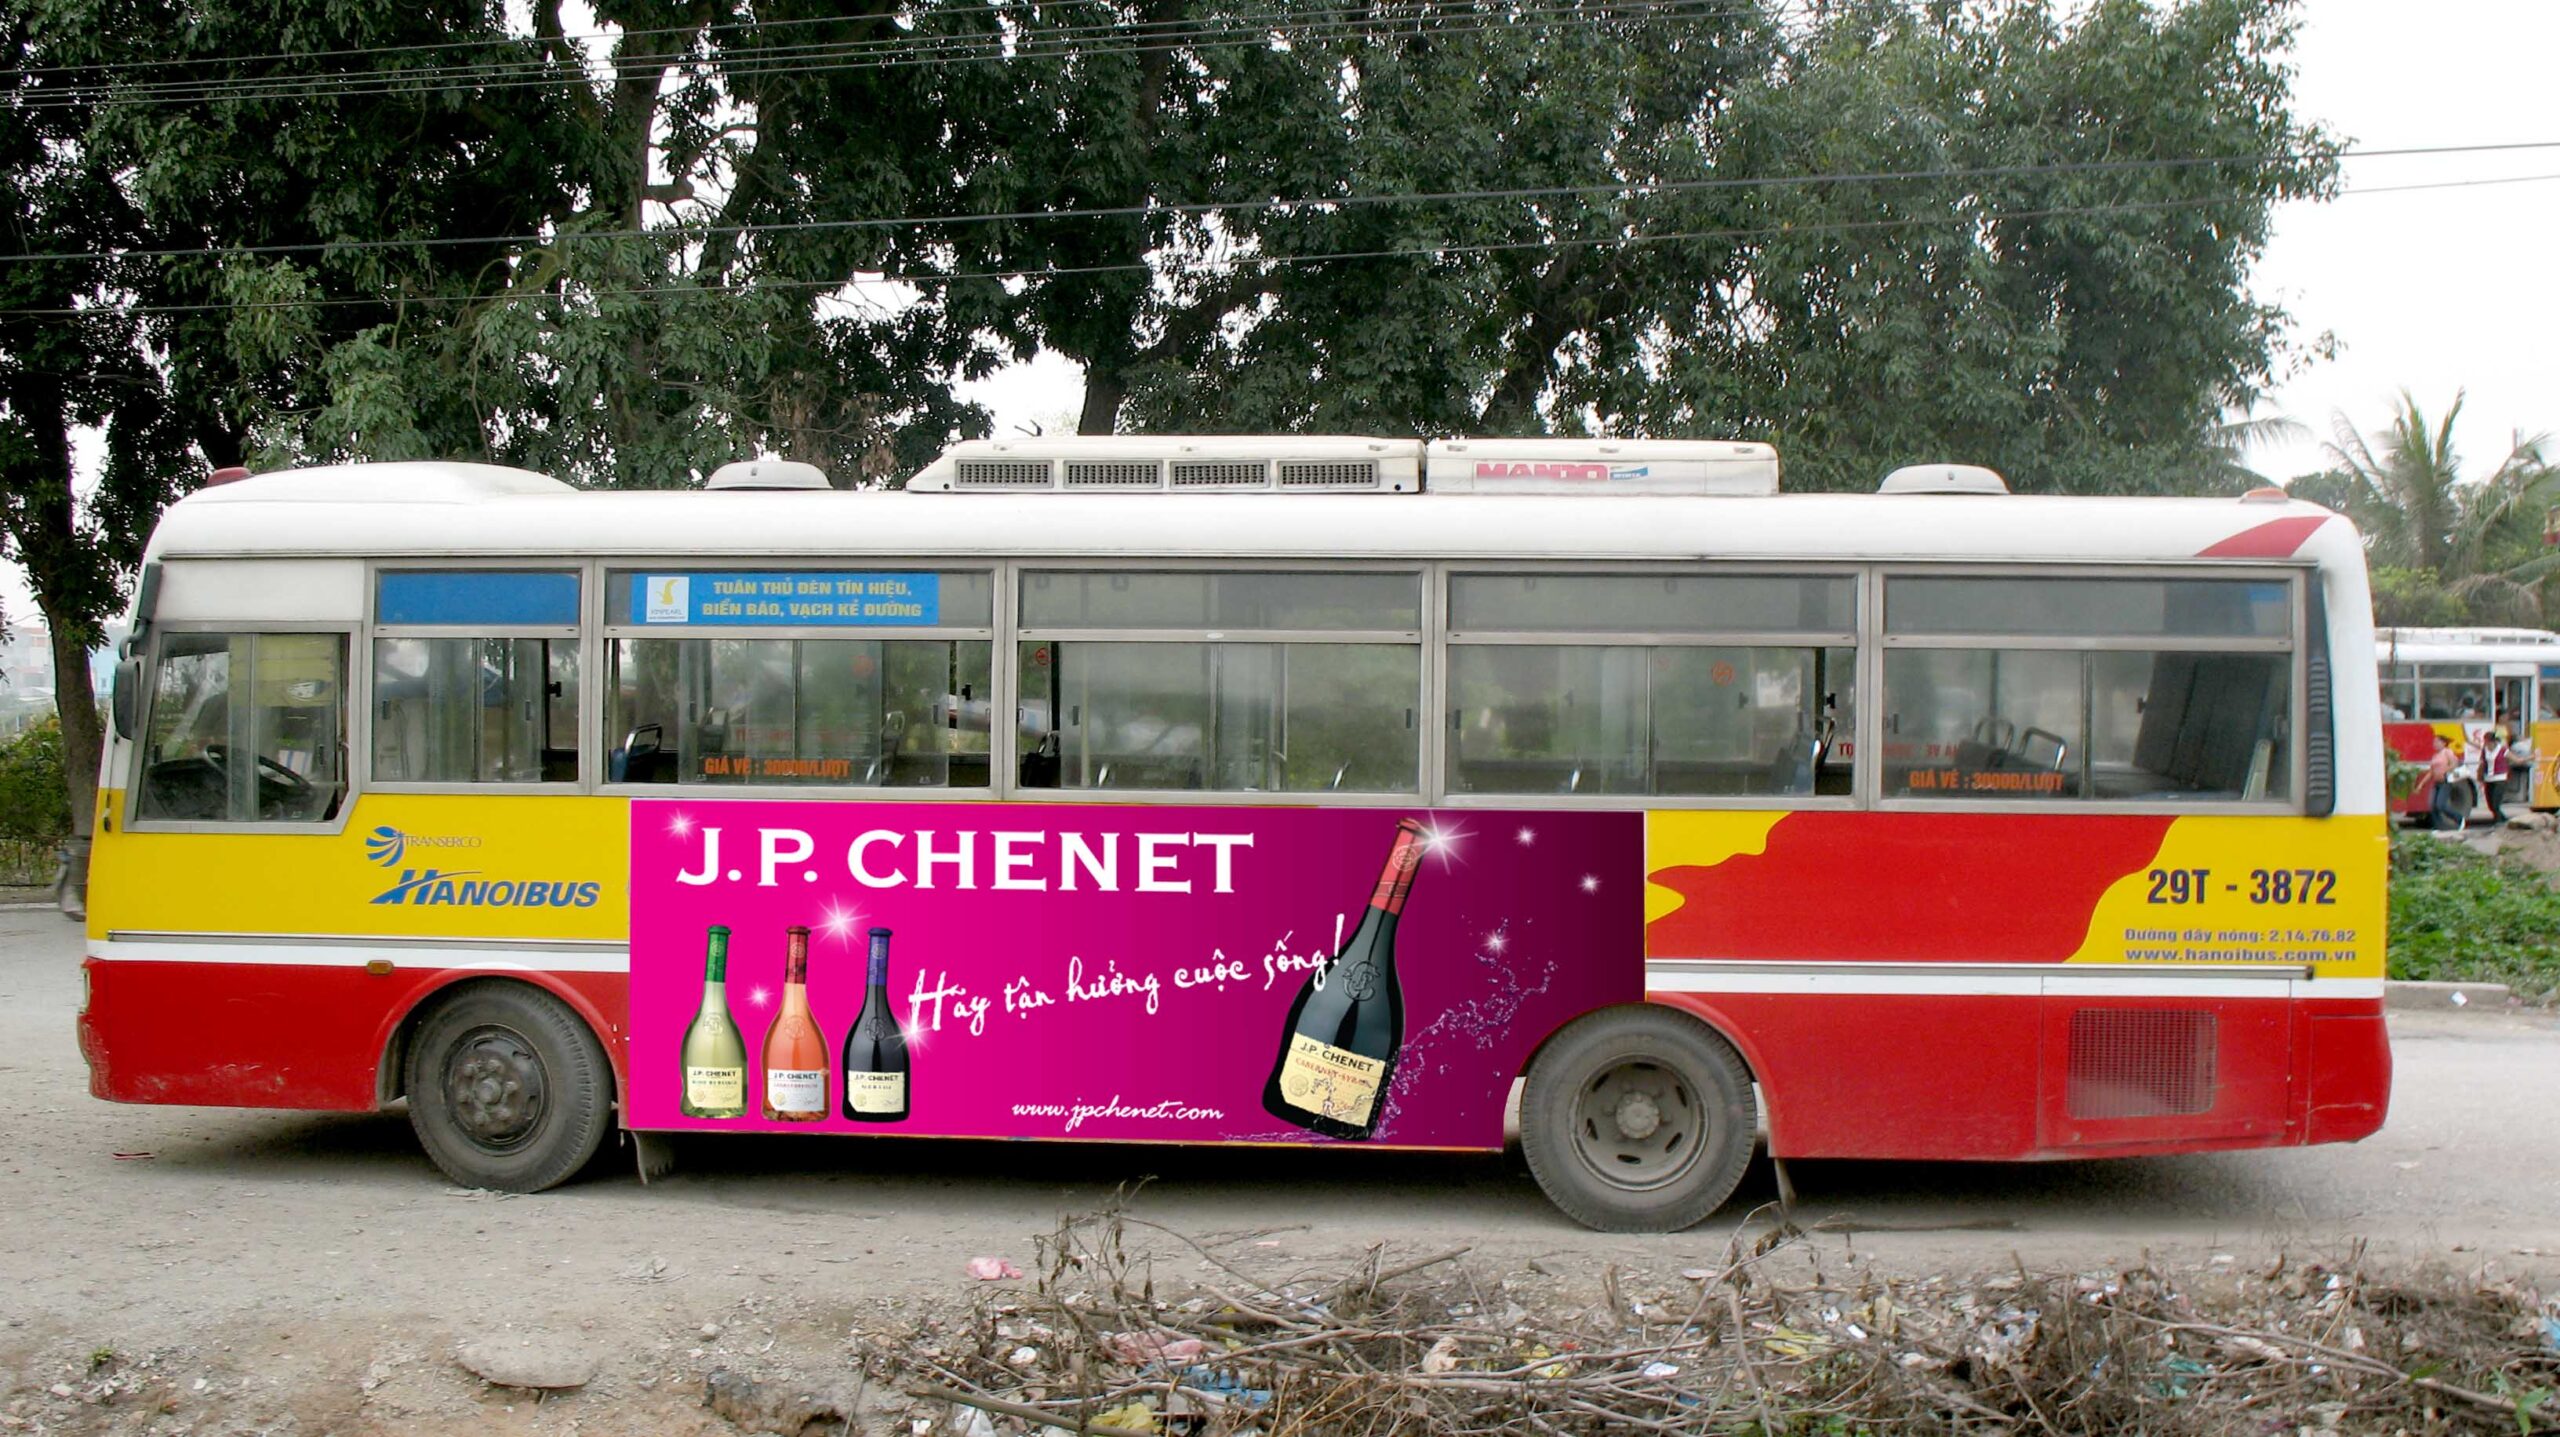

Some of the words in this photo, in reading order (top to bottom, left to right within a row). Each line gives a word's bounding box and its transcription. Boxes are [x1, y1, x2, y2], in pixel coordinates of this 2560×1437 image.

[1476, 463, 1608, 482] MANDO
[713, 579, 757, 595] TUÂN
[705, 755, 730, 775] GIÁ
[1909, 768, 1936, 788] GIÁ
[1940, 768, 1959, 788] VÉ
[403, 835, 482, 848] TRANSERCO
[676, 827, 818, 887] J.P.
[846, 829, 1254, 894] CHENET
[368, 869, 601, 908] HANOIBUS
[2146, 869, 2211, 904] 29T
[2249, 869, 2337, 905] 3872
[2125, 948, 2356, 961] www.hanoibus.com.vn
[1003, 976, 1056, 1020] tận
[1065, 956, 1161, 1015] hưởng
[1173, 947, 1252, 992] cuộc
[1263, 913, 1345, 992] sống!
[1322, 1050, 1374, 1072] CHENET
[1011, 1094, 1225, 1133] www.jpchenet.com
